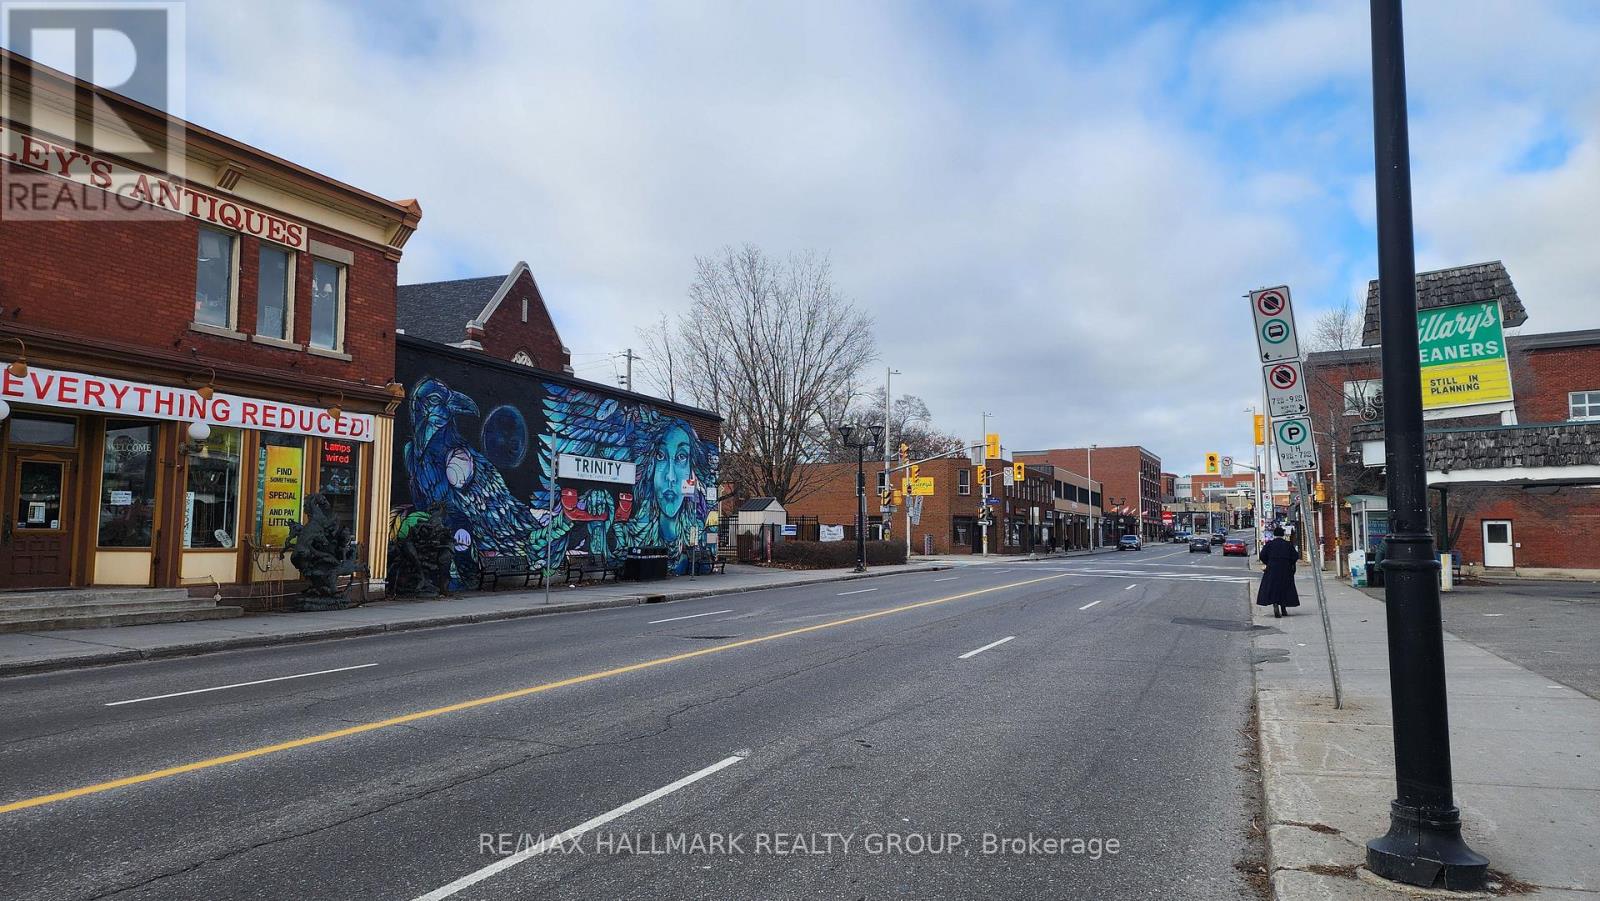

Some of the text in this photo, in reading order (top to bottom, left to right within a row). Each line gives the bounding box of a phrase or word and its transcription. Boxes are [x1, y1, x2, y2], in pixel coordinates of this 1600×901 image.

[130, 174, 303, 249] ANTIQUES
[1418, 304, 1496, 345] illary's
[1419, 341, 1499, 363] EANERS
[1430, 374, 1479, 387] STILL IN
[1431, 383, 1480, 395] PLANNING
[1, 368, 371, 438] EVERYTHING REDUCED!
[107, 443, 152, 452] WELCOME
[324, 441, 351, 453] Lamps
[326, 453, 349, 463] wired
[276, 467, 292, 476] FIND
[574, 457, 622, 476] TRINITY
[269, 491, 297, 500] SPECIAL
[269, 508, 295, 516] AND PAY
